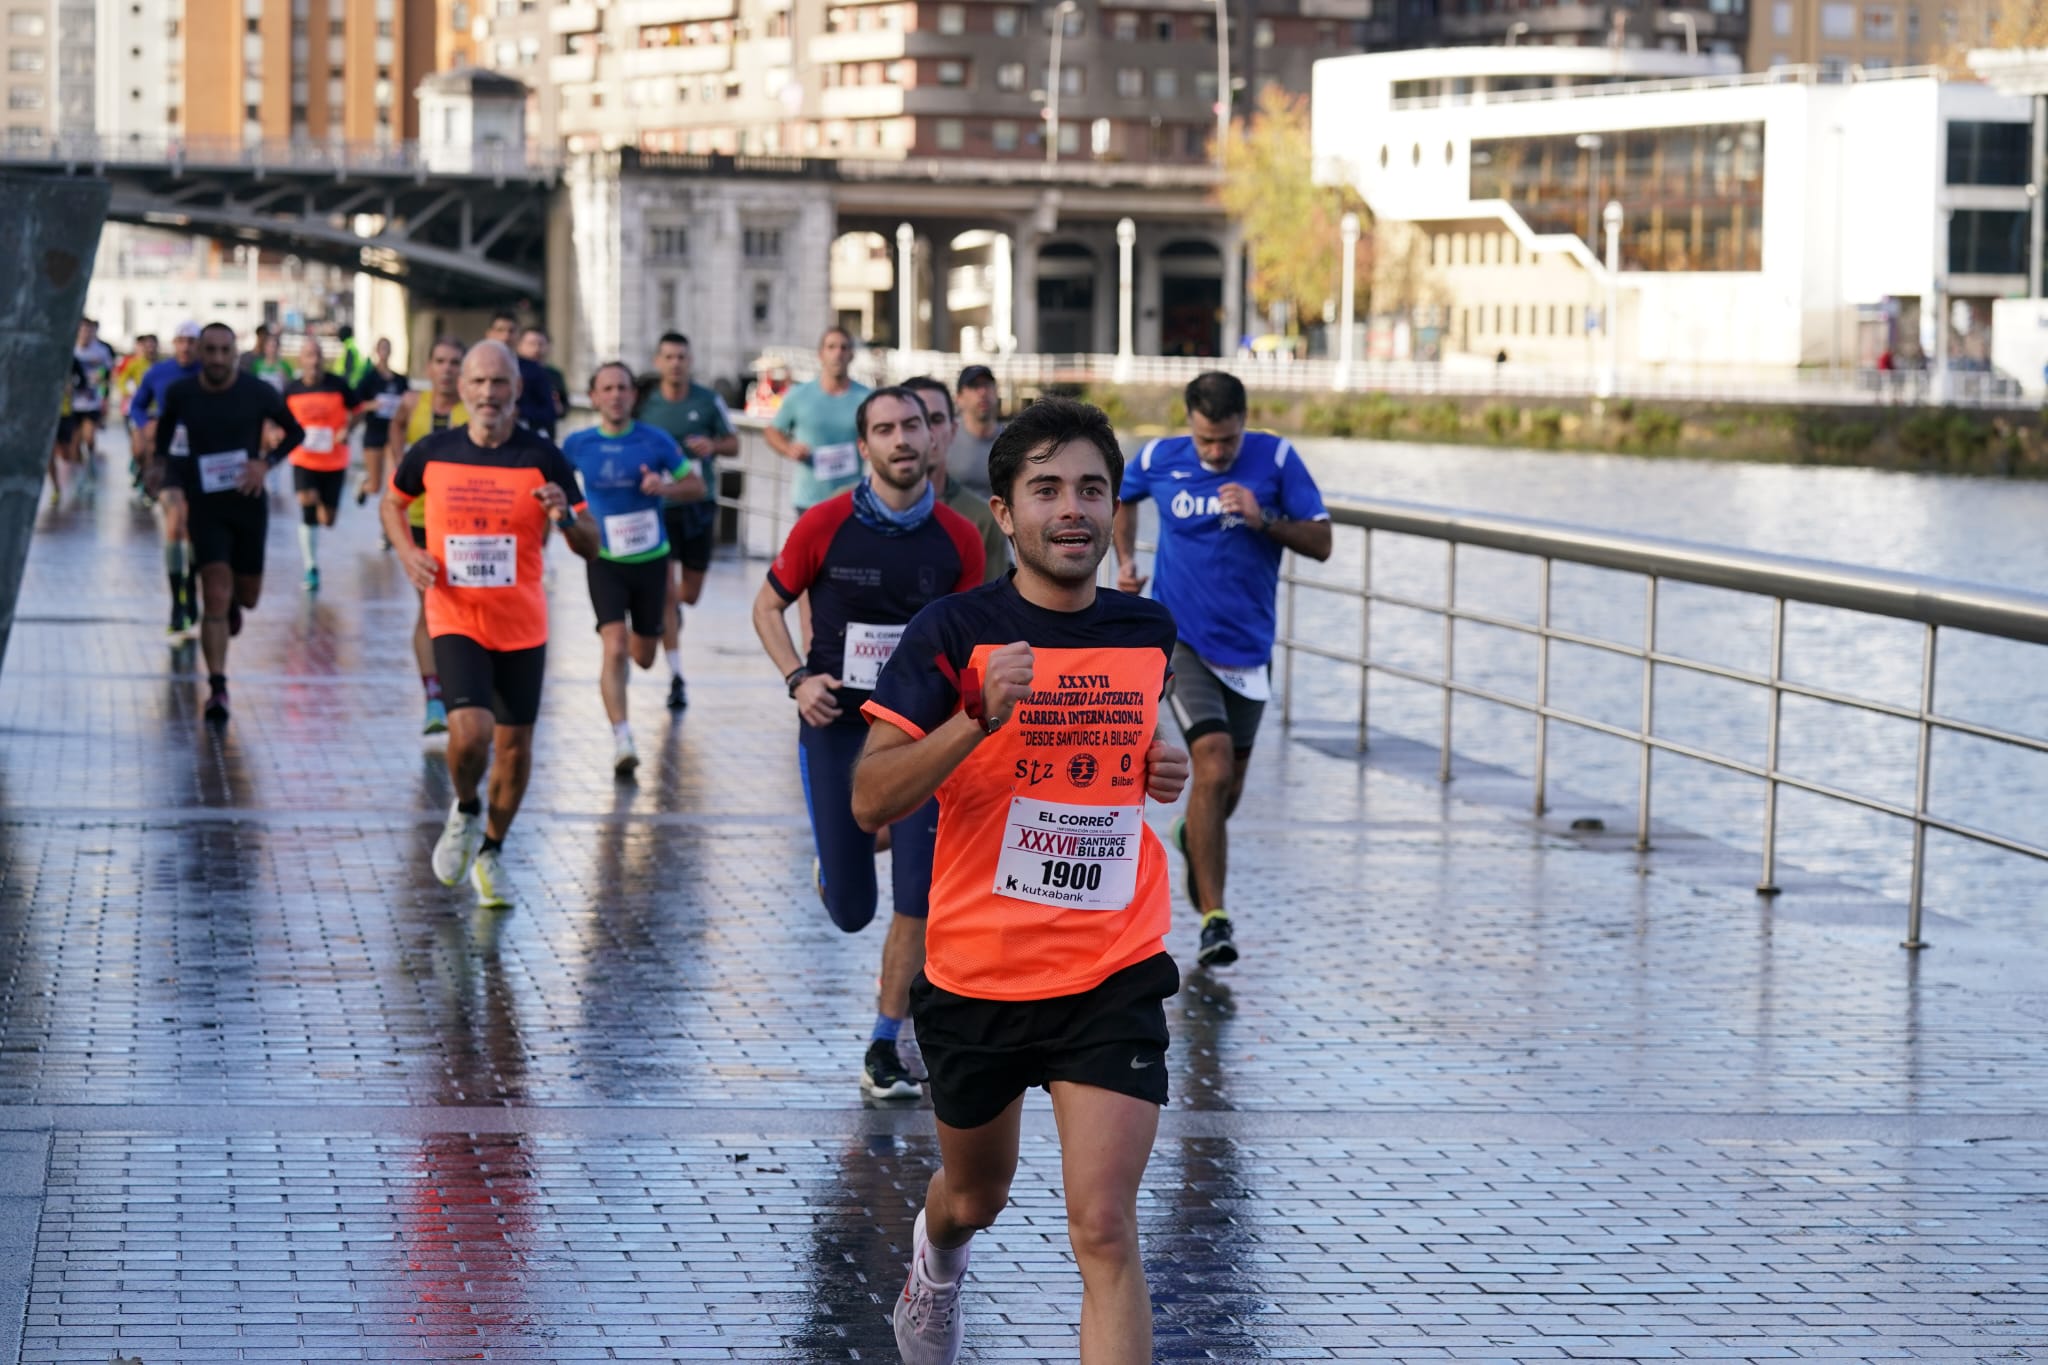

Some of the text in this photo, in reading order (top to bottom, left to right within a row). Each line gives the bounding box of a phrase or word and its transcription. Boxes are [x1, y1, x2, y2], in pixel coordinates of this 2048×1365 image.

[1058, 675, 1110, 688] XXXVII
[1088, 692, 1144, 706] LASTERKETA
[1019, 710, 1144, 725] CARRERA INTERNACIONAL
[1056, 731, 1100, 746] SANTURCE
[1102, 731, 1109, 746] A
[1038, 811, 1114, 827] EL CORREO
[1018, 828, 1078, 856] XXXVII
[1079, 836, 1127, 847] SANTURCE
[1077, 846, 1125, 857] BILBAO
[1041, 860, 1102, 891] 1900
[1022, 883, 1084, 903] kutxabank
